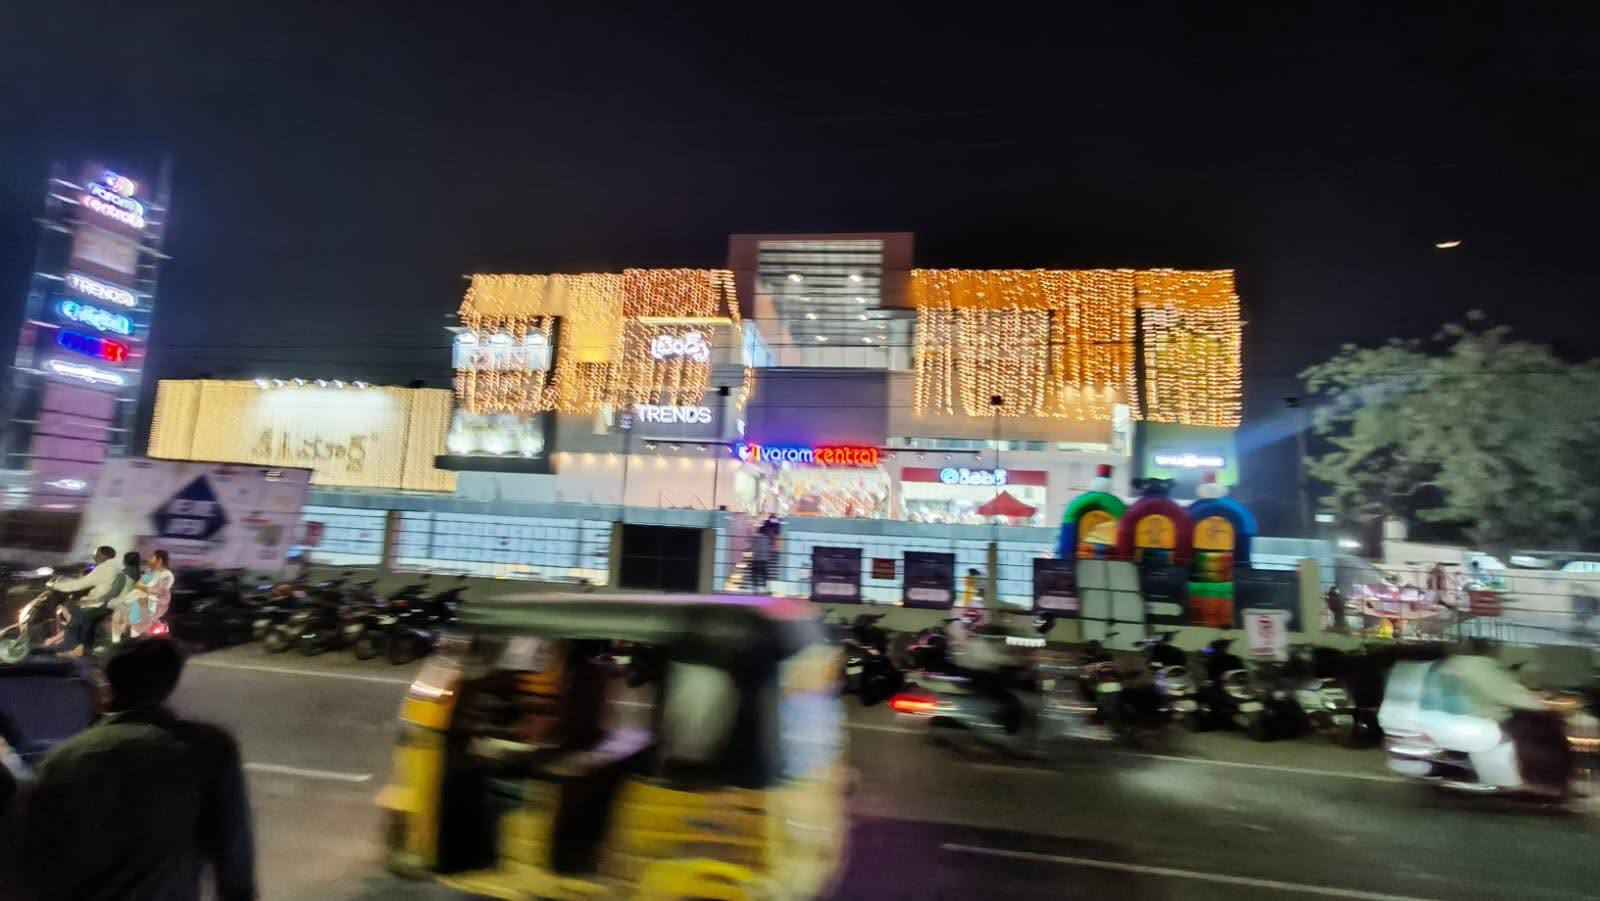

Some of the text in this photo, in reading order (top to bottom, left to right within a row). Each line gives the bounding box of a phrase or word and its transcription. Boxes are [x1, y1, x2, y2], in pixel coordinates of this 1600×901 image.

[67, 274, 136, 306] TRENDS
[637, 404, 712, 423] TRENDS
[760, 445, 879, 465] varam central
